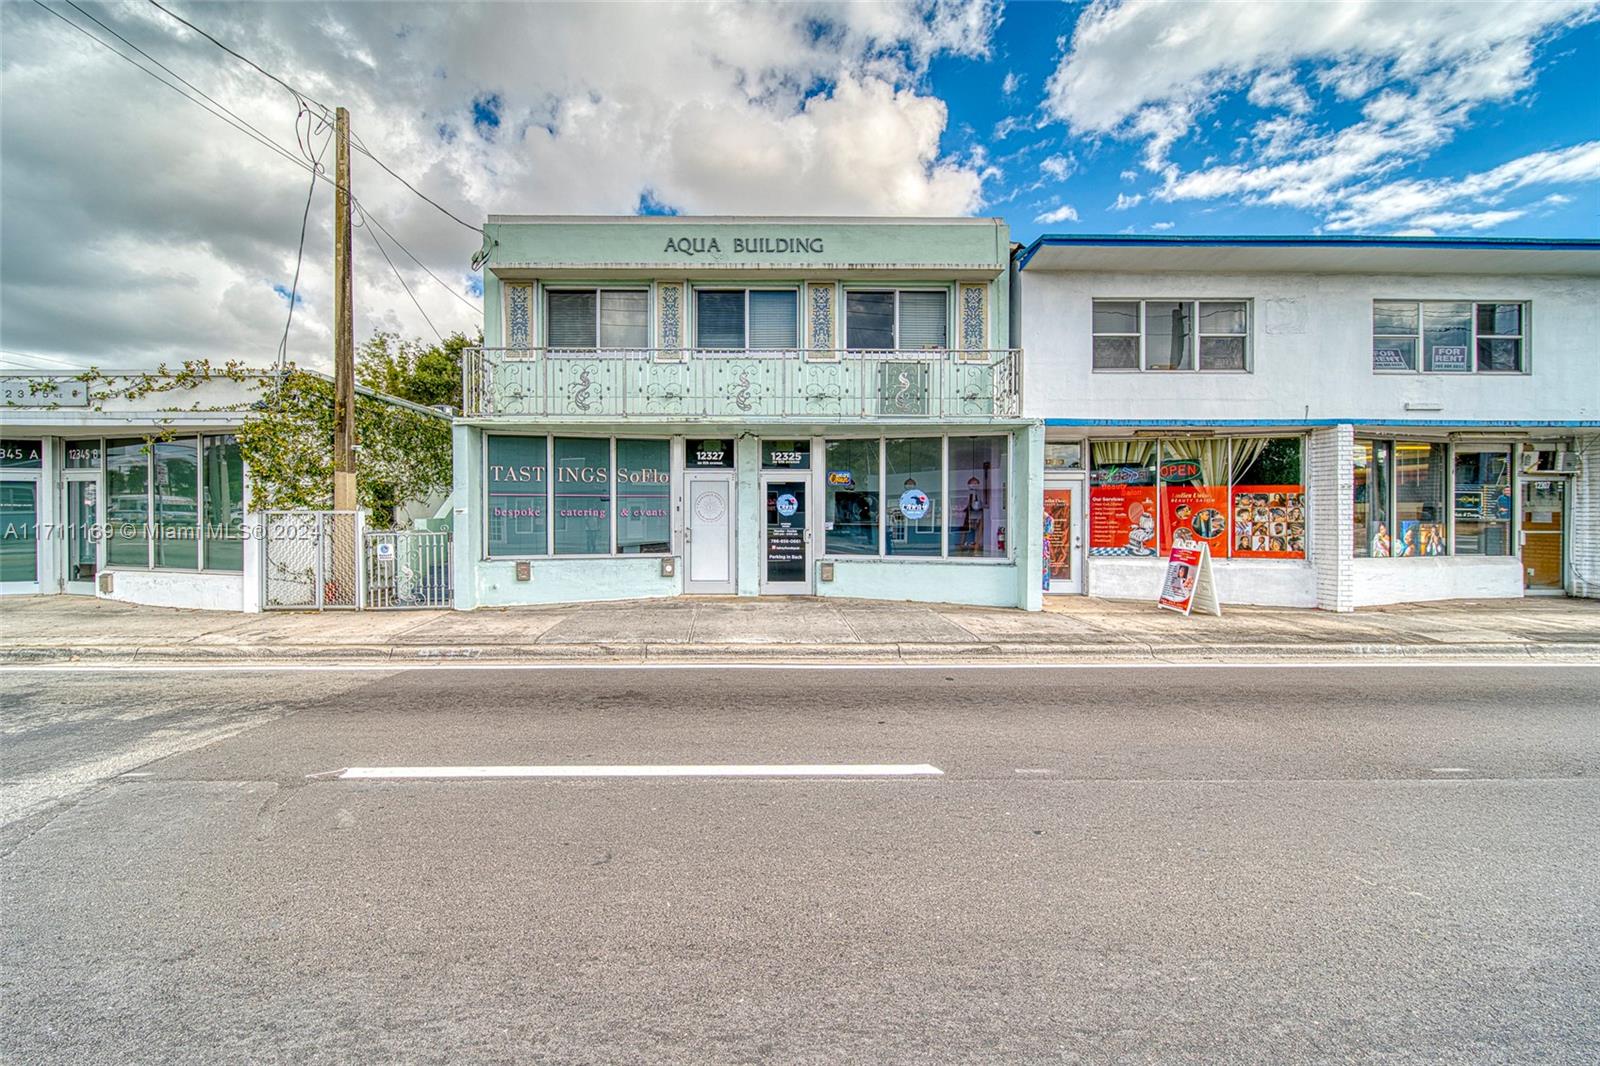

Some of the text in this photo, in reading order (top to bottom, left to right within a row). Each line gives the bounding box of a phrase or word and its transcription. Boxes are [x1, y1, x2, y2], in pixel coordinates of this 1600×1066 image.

[664, 237, 824, 256] AQUA BUILDING
[29, 449, 39, 460] A
[69, 448, 90, 460] 12345
[696, 451, 724, 460] 12327
[770, 451, 802, 461] 12325
[617, 469, 669, 484] SoFlo
[1159, 464, 1197, 477] OPEN
[494, 507, 668, 519] bespoke catering & events
